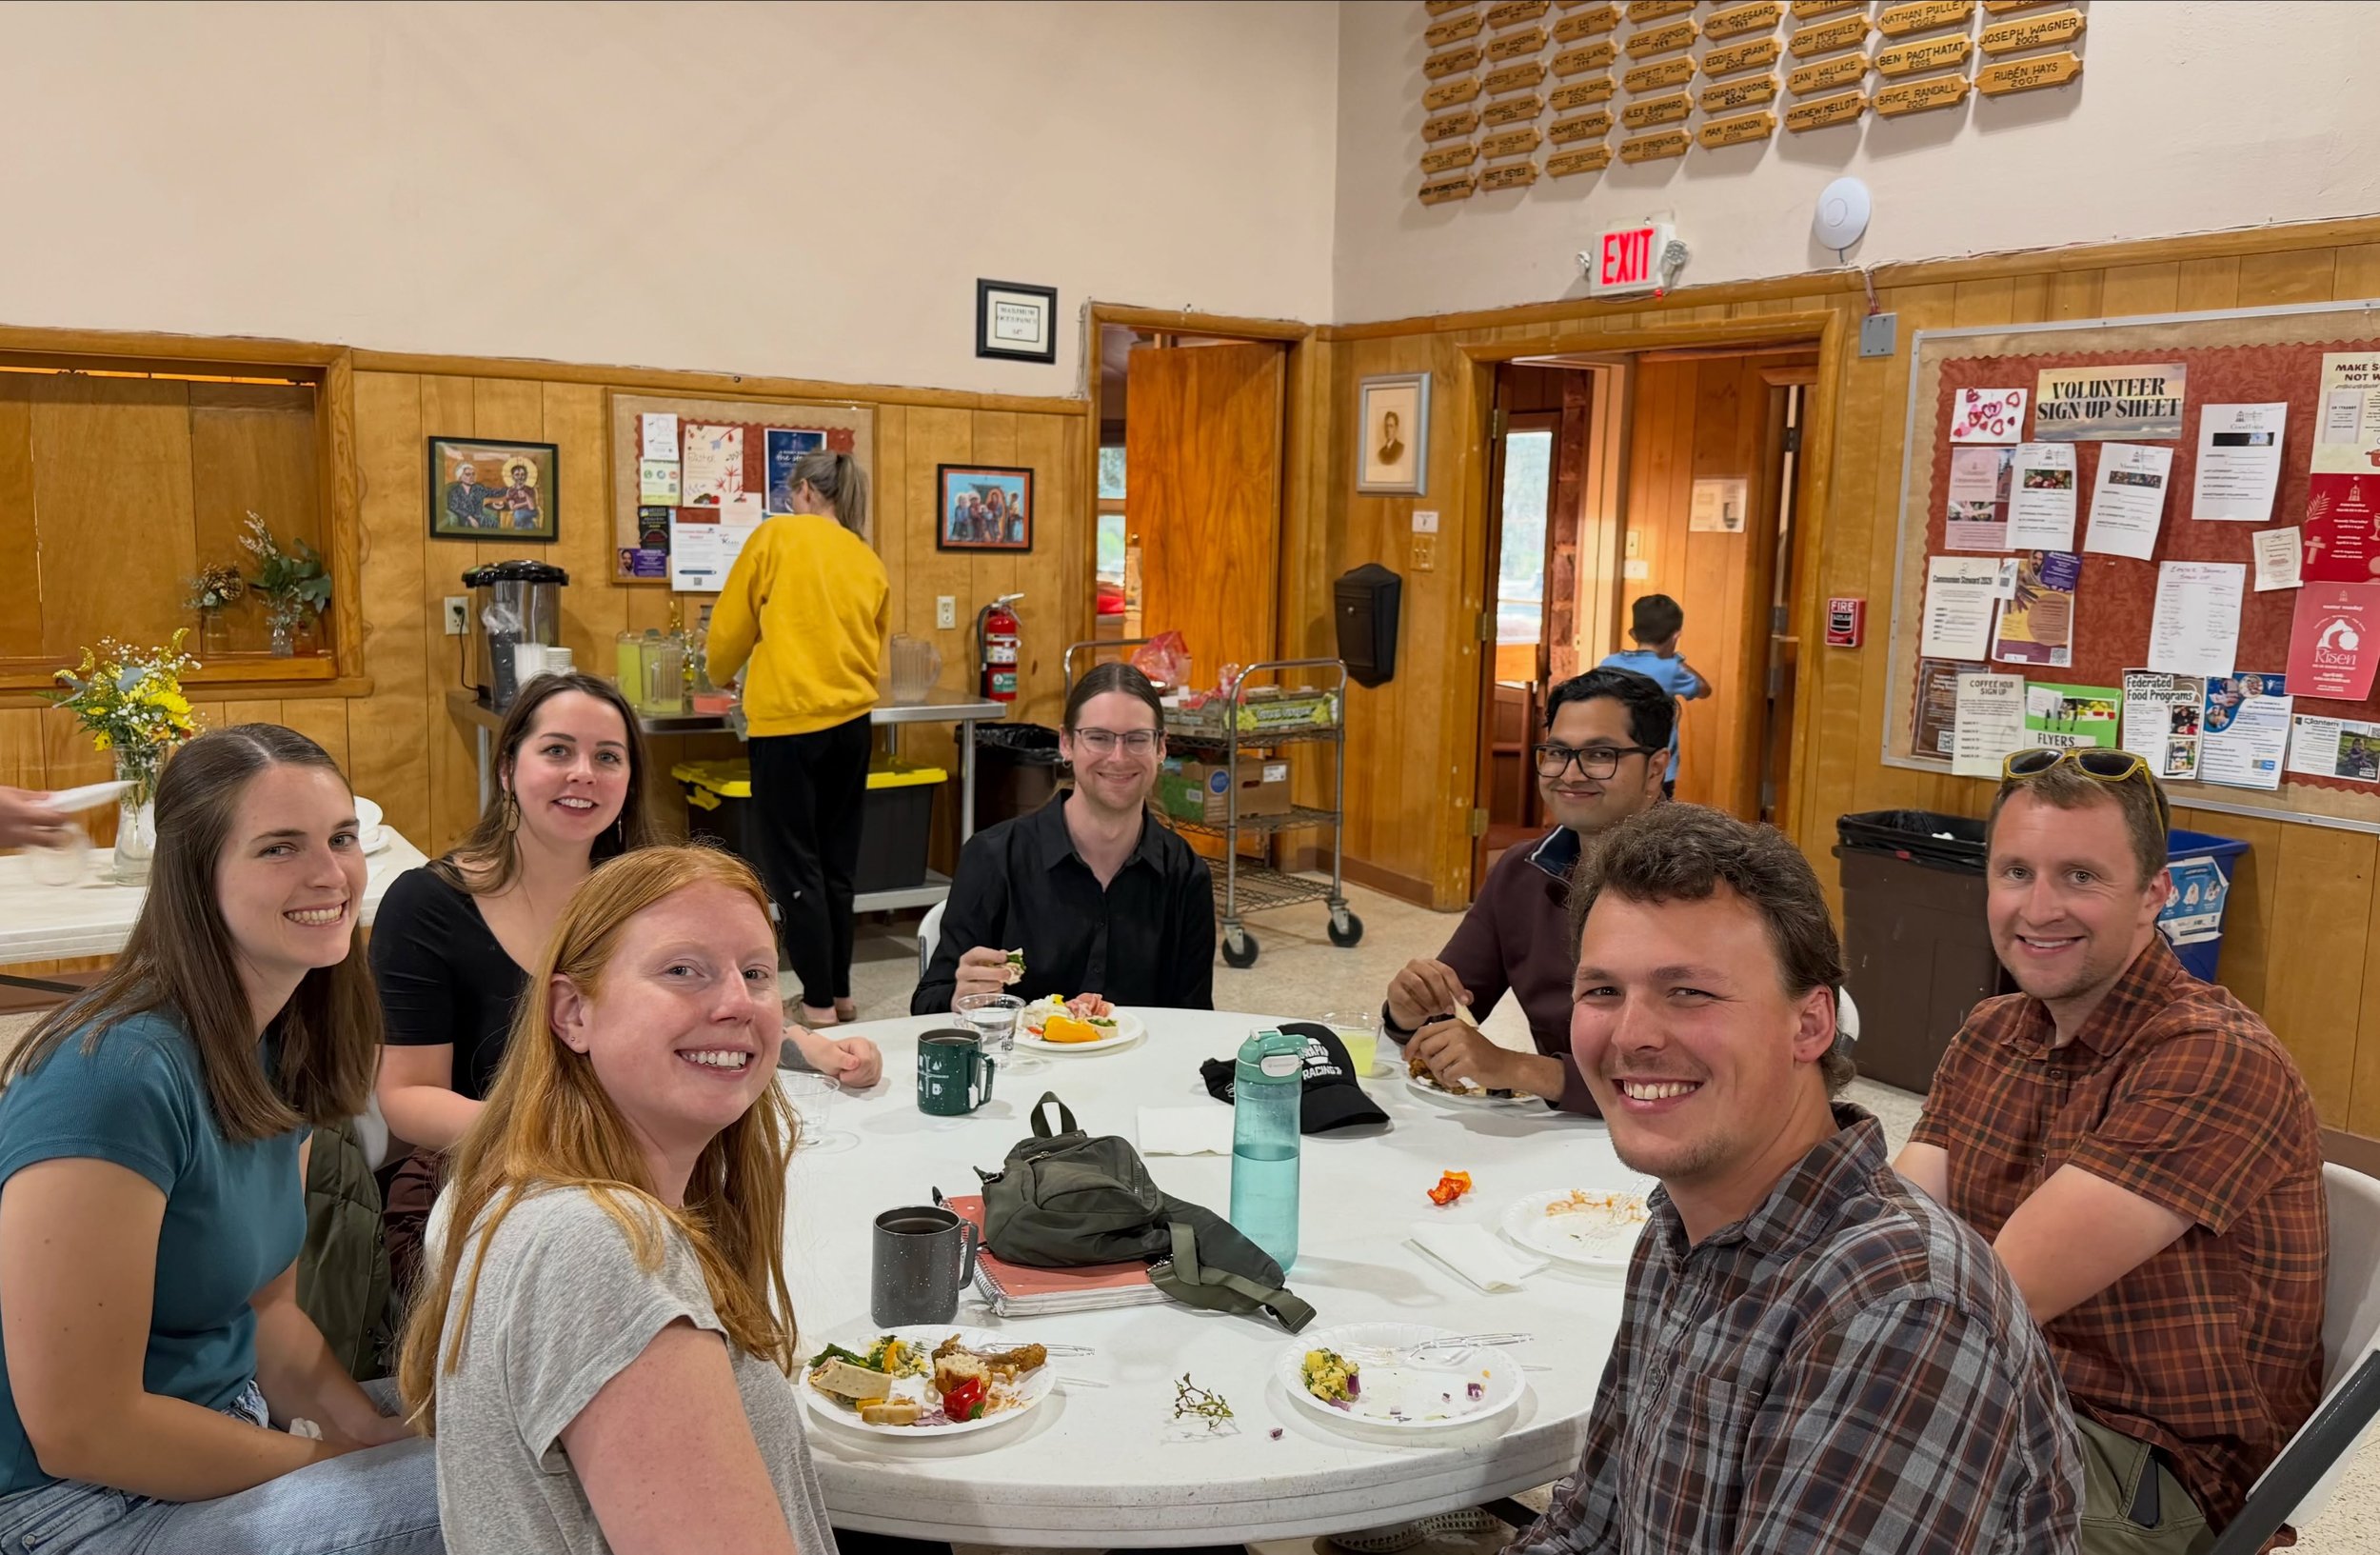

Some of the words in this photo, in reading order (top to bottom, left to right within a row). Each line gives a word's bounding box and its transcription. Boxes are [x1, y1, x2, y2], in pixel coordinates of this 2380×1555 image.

[1881, 9, 1922, 25] NATHAN
[1926, 1, 1966, 16] PULLEY
[1909, 15, 1936, 28] 2002
[1980, 29, 2024, 45] JOSEPH
[2029, 18, 2077, 35] WAGNER
[1791, 36, 1813, 48] JOSH
[1706, 52, 1733, 67] EDDIE
[1740, 43, 1772, 57] GRANT
[1879, 54, 1901, 67] BEN
[1793, 73, 1812, 85] IAN
[1817, 61, 1857, 76] WALLACE
[1993, 64, 2028, 82] RUBÉN
[2032, 62, 2058, 75] HAYS
[1738, 80, 1772, 94] NOONE
[2011, 75, 2039, 88] 2007
[1878, 90, 1909, 106] BRYCE
[1914, 83, 1957, 100] RANDALL
[1906, 97, 1930, 109] 2007
[1787, 108, 1820, 122] MATTHEW
[1822, 97, 1859, 113] MELLOTT
[1601, 228, 1654, 285] EXIT
[2053, 377, 2166, 399] VOLUNTEER
[2037, 401, 2081, 420] SIGN
[2085, 400, 2112, 419] UP
[2115, 398, 2181, 419] SHEET
[1831, 601, 1854, 611] FIRE
[2315, 648, 2356, 666] Risen
[2126, 676, 2172, 688] Federated
[2127, 689, 2148, 701] Food
[2150, 689, 2193, 704] Programs
[2037, 732, 2075, 748] FLYERS
[1302, 1066, 1336, 1081] RACING
